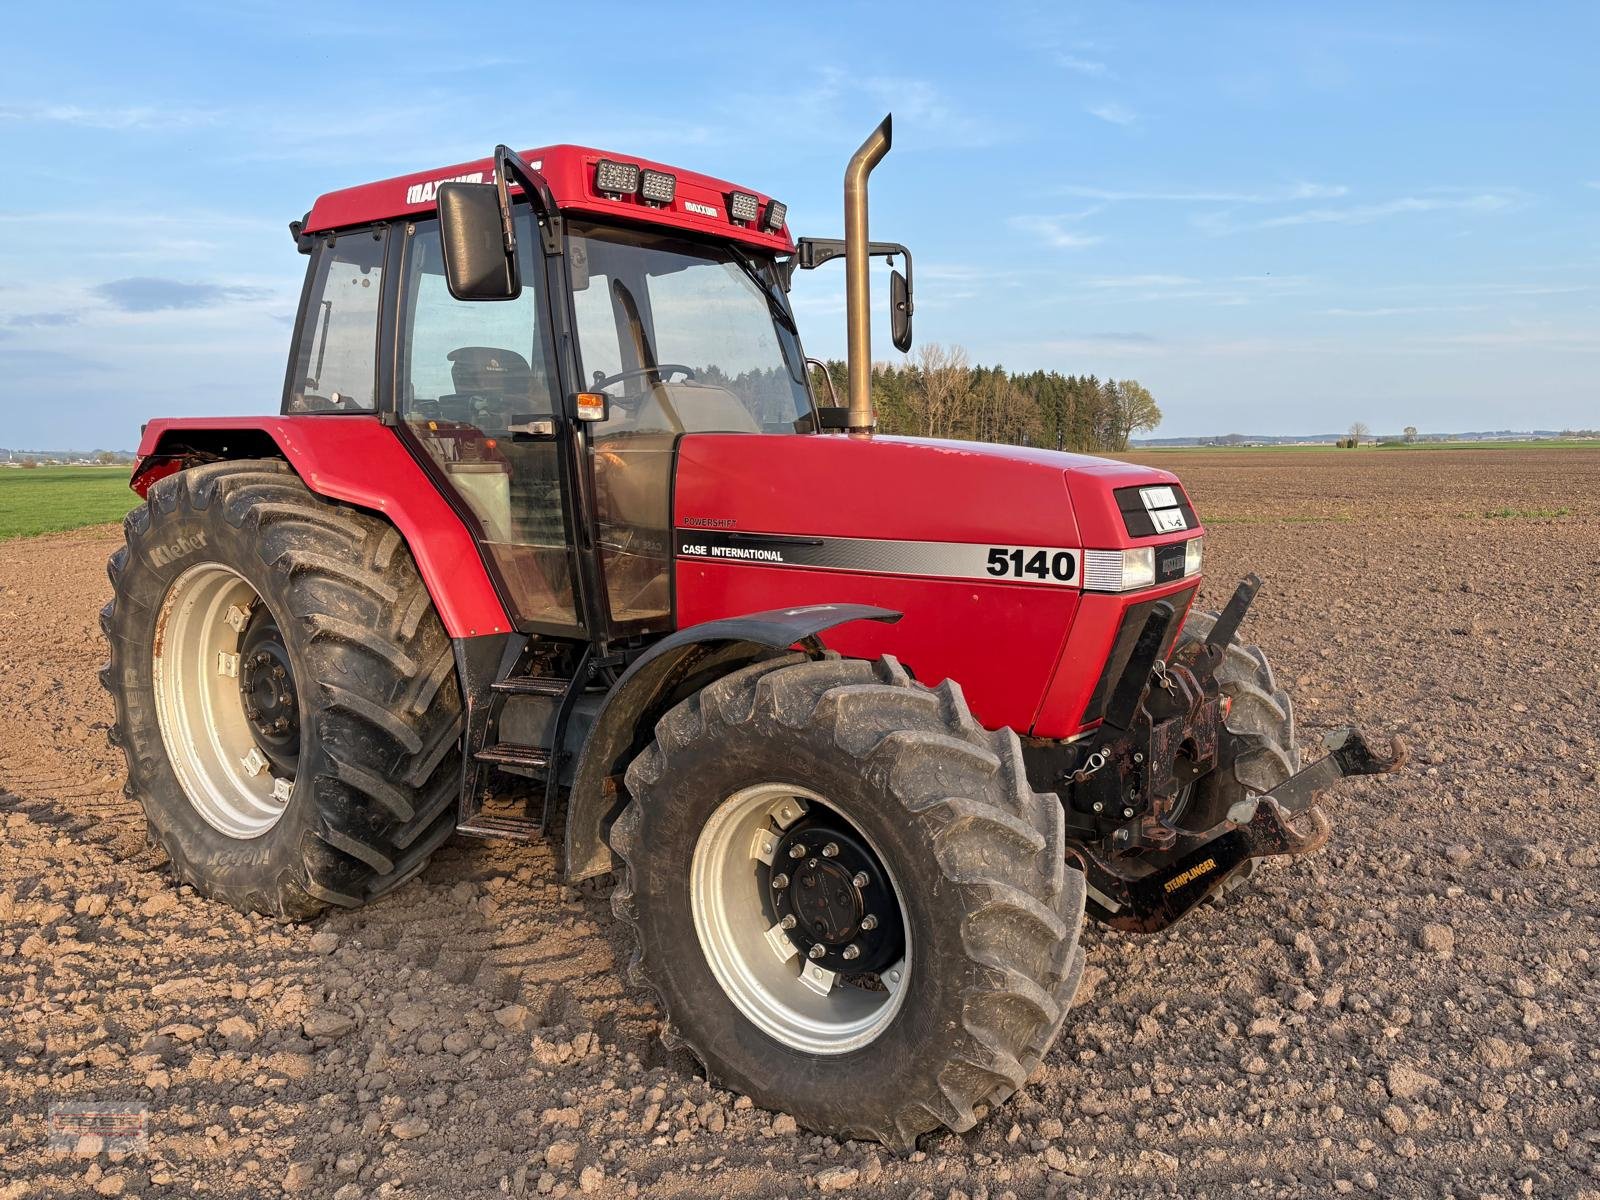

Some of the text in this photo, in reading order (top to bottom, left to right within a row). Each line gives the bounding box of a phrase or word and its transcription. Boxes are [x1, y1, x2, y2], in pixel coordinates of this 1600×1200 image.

[684, 201, 718, 218] MAXXUM
[684, 517, 737, 528] POWERSHIFT
[149, 527, 208, 568] Kleber
[682, 544, 784, 562] CASE INTERNATIONAL
[986, 547, 1076, 581] 5140
[1164, 858, 1216, 893] STEMPLINGER
